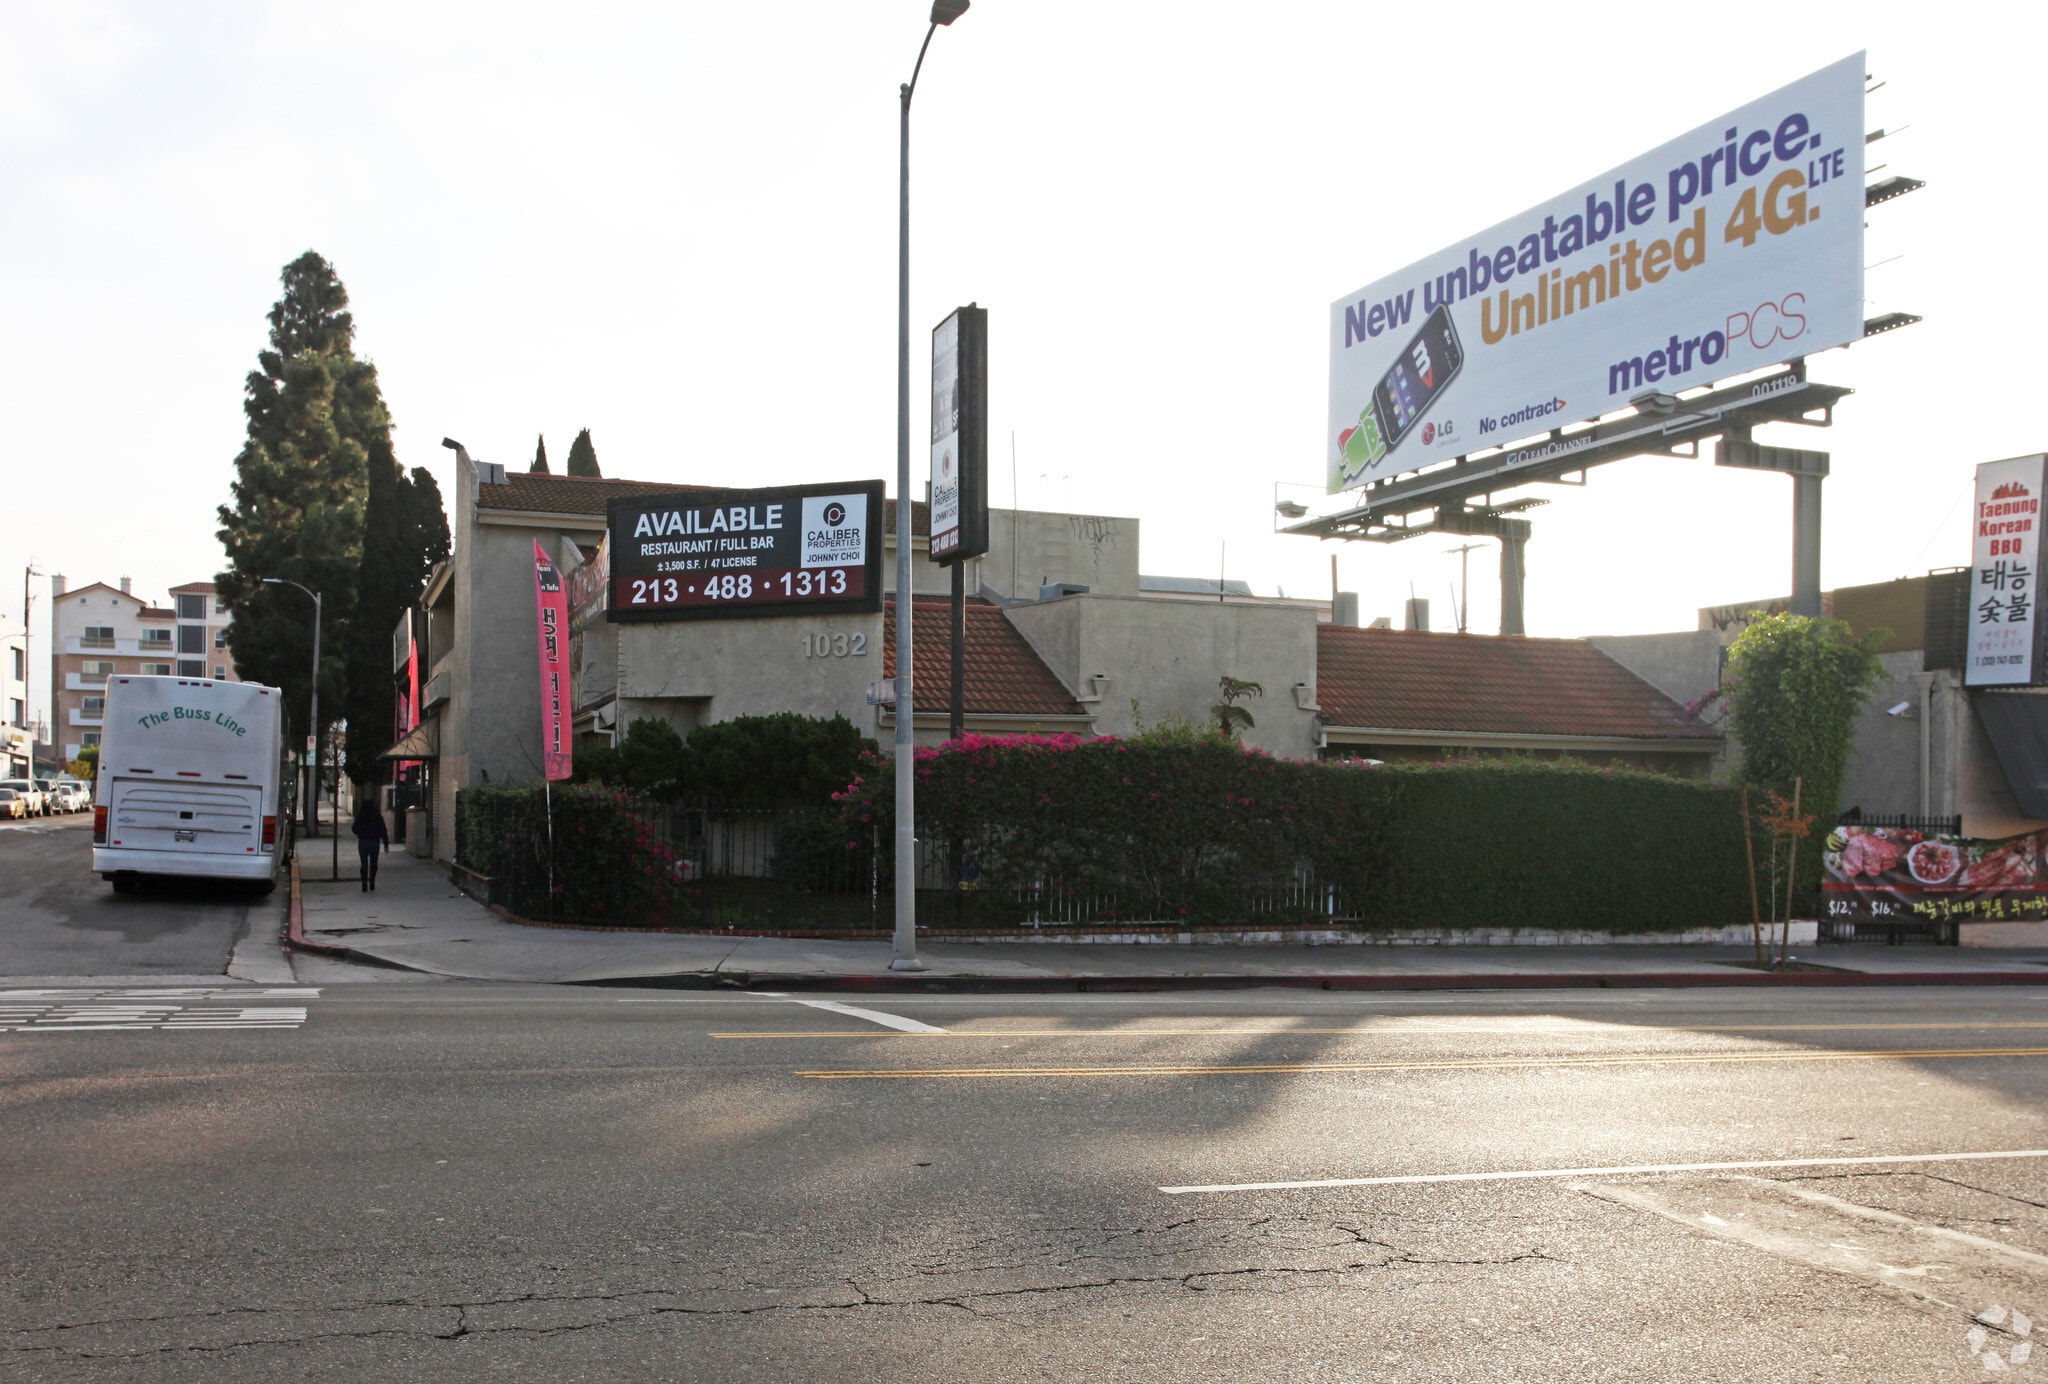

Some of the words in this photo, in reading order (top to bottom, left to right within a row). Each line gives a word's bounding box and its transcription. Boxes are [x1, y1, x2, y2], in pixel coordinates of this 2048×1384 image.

[1808, 147, 1844, 189] LTE
[1345, 288, 1415, 348] New
[1424, 179, 1657, 315] unbeatable
[1668, 112, 1821, 224] price.
[1481, 206, 1706, 345] Unlimited
[1724, 168, 1820, 248] 4G.
[1609, 292, 1806, 395] metroPCS
[1438, 420, 1453, 437] LG
[1479, 417, 1497, 435] No
[1979, 498, 2038, 519] Taenung
[634, 504, 783, 538] AVAILABLE
[1979, 519, 2032, 537] Korean
[641, 539, 712, 556] RESTAURANT
[720, 538, 748, 552] FULL
[750, 536, 774, 550] BAR
[807, 528, 860, 541] CALIBER
[807, 538, 861, 549] PROPERTIES
[807, 553, 839, 562] JOHNNY
[840, 551, 860, 561] CHOI
[1990, 538, 2022, 556] BBQ
[665, 559, 685, 571] 3,500
[687, 559, 701, 570] S.F.
[711, 558, 721, 569] 47
[722, 556, 757, 568] LICENSE
[1980, 560, 2032, 591] 태능
[632, 578, 679, 604] 213
[703, 574, 753, 600] 488
[780, 569, 847, 596] 1313
[1978, 592, 2031, 624] 숯불
[802, 632, 867, 659] 1032
[137, 711, 169, 730] The
[173, 706, 211, 721] Buss
[215, 712, 247, 737] Line
